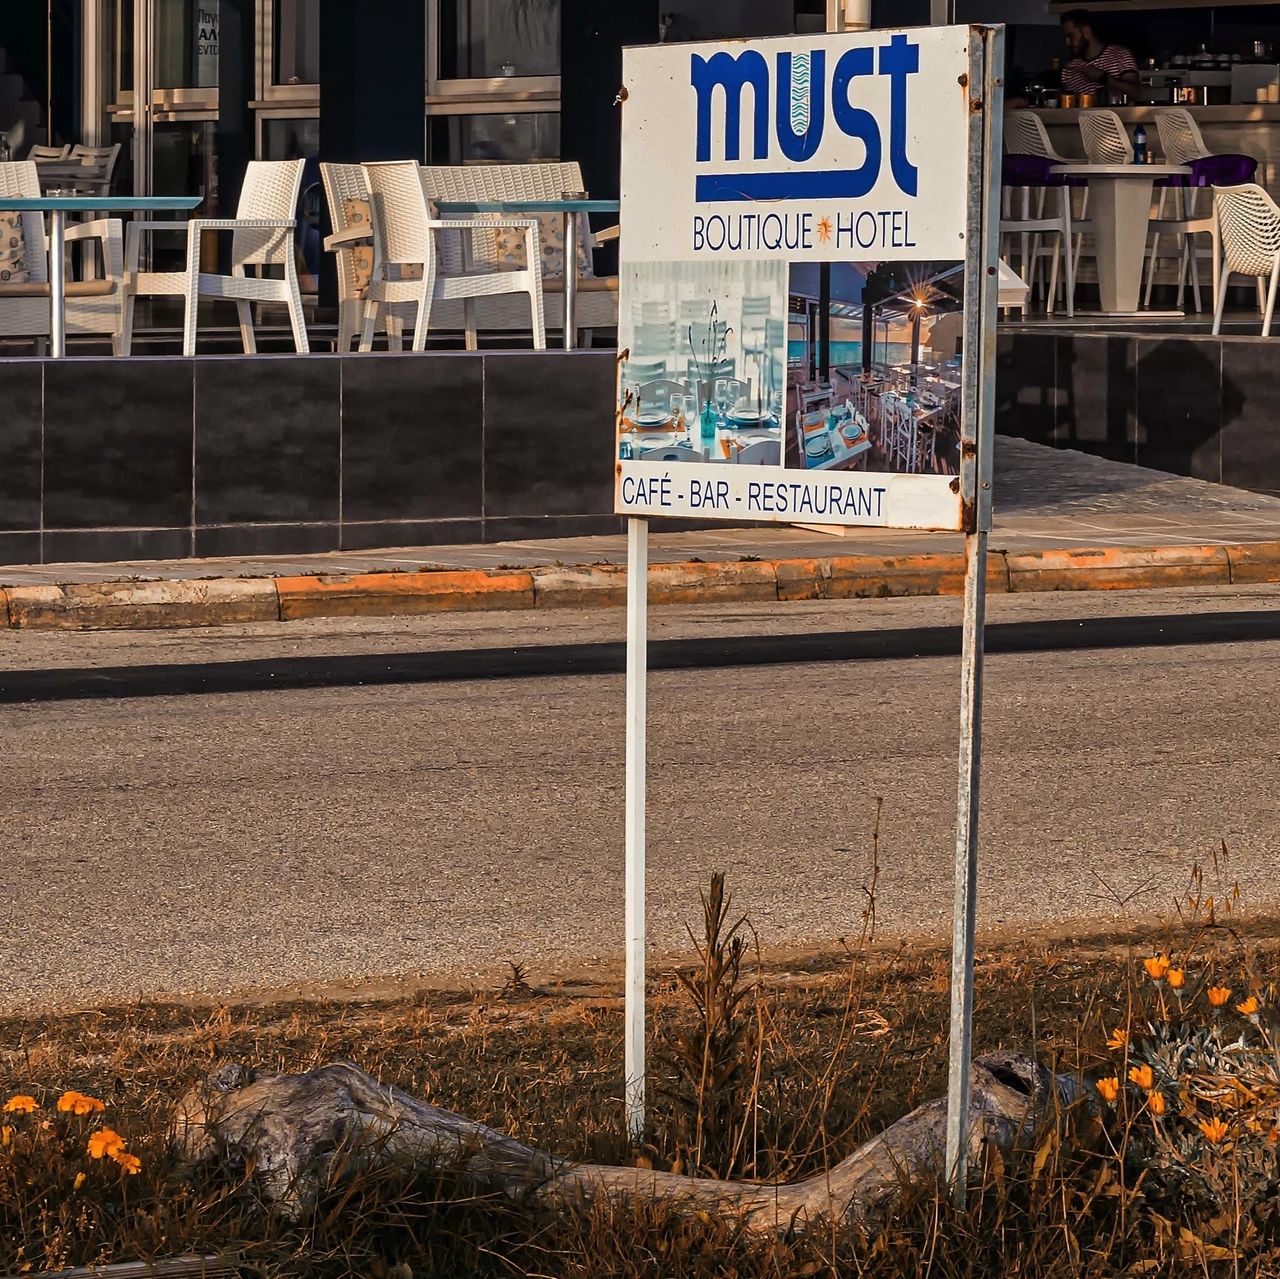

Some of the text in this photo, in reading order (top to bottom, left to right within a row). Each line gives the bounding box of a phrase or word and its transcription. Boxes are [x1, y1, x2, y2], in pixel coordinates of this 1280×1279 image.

[691, 34, 920, 202] must
[692, 211, 916, 250] BOUTIQUE HOTEL
[622, 472, 672, 507] CAFÉ
[690, 479, 729, 509] BAR
[748, 482, 886, 517] RESTAURANT
